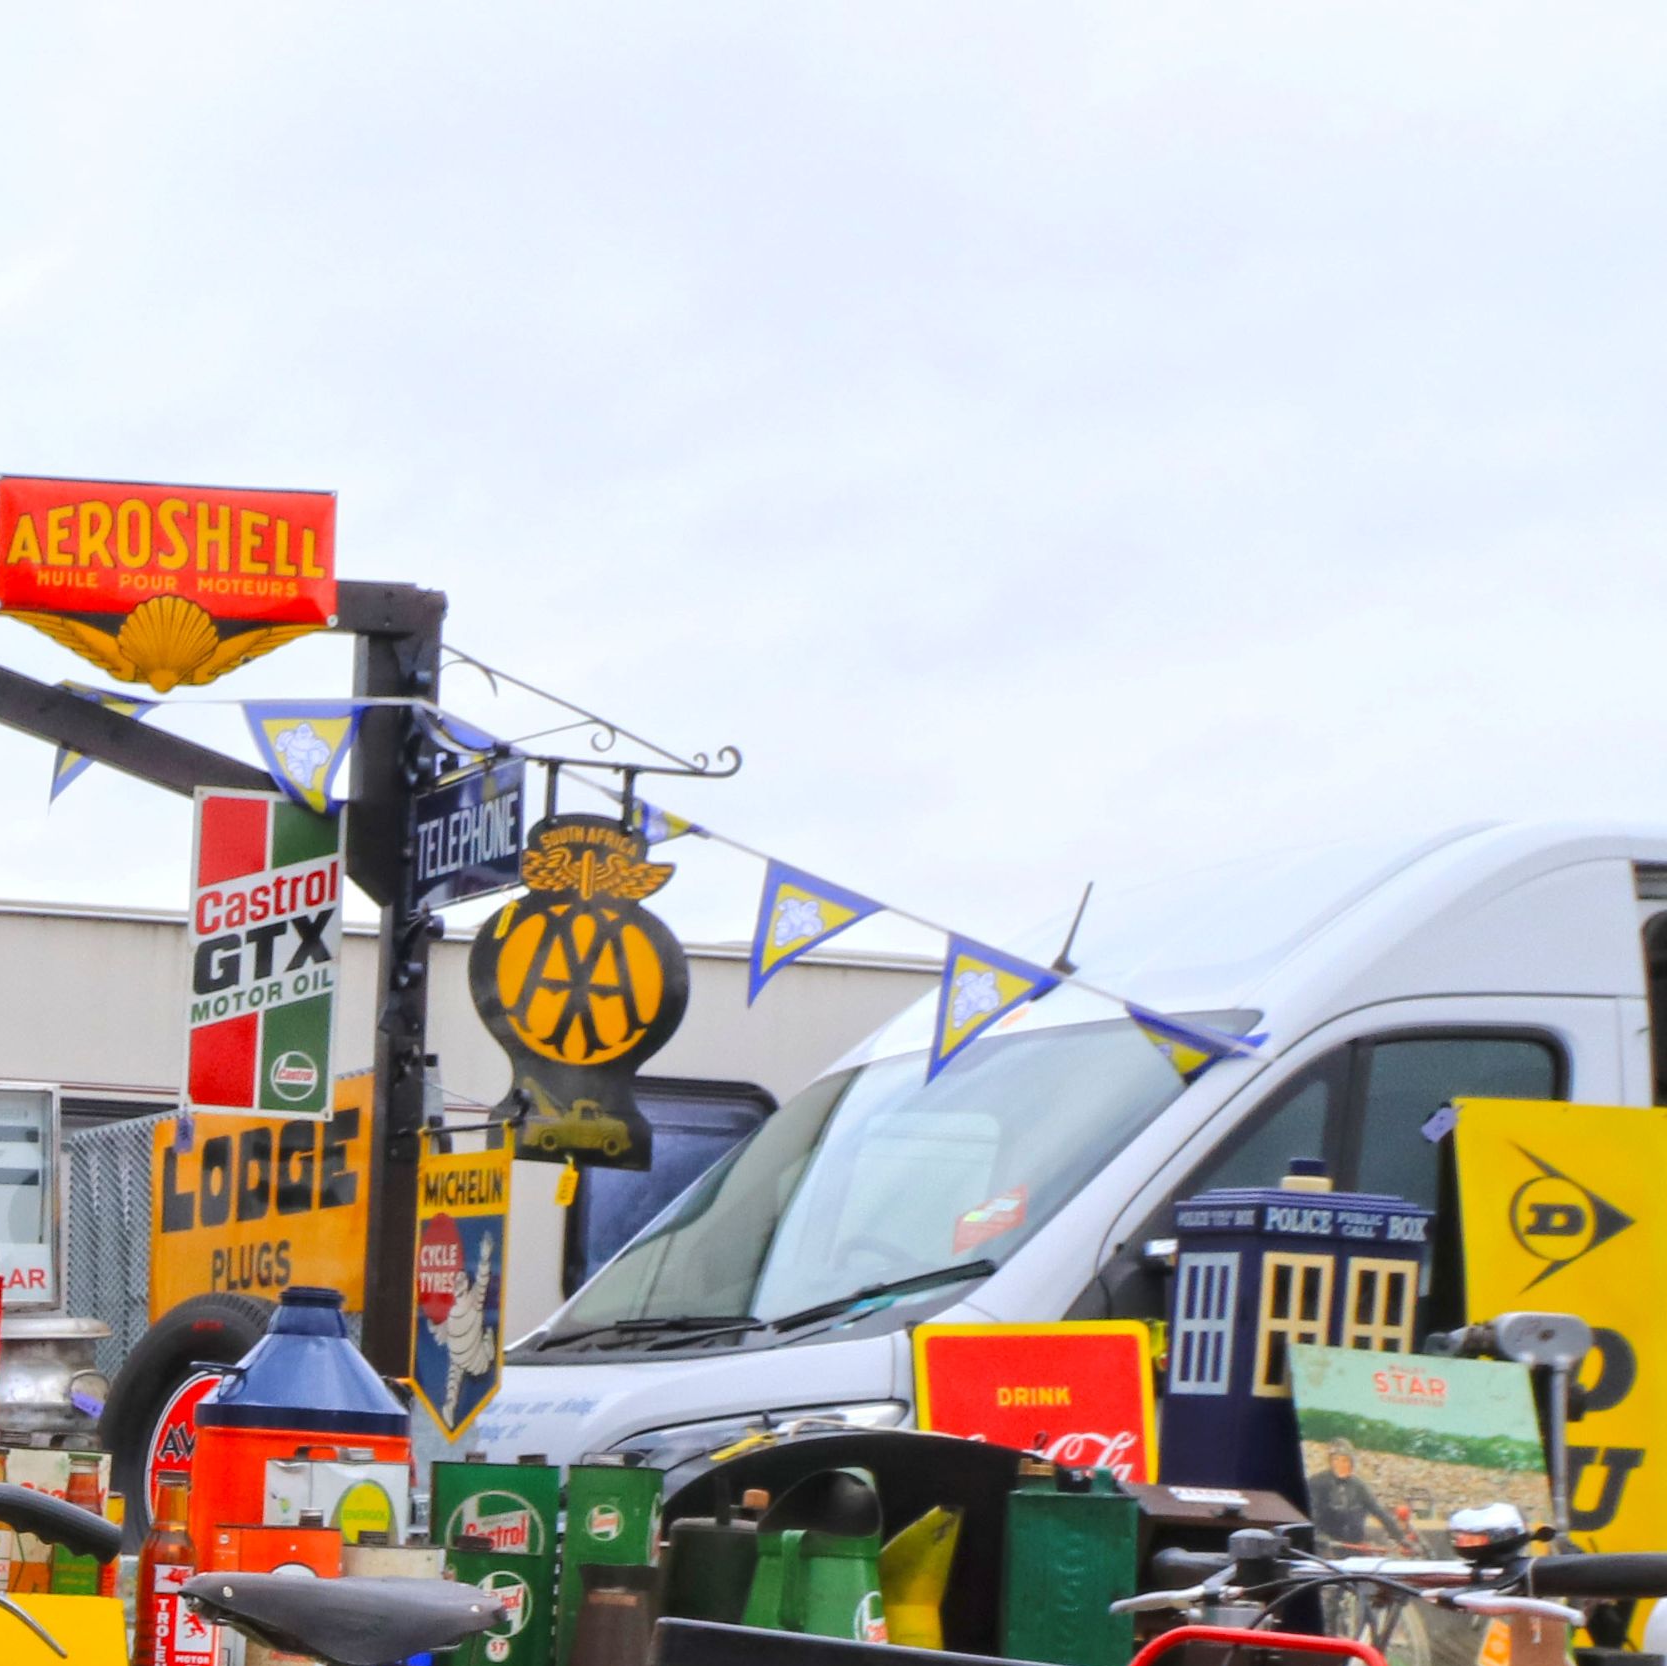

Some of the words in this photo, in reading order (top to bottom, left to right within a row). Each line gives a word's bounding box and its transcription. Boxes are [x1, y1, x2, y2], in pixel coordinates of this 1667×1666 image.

[8, 499, 325, 580] AEROSHELL
[36, 571, 98, 590] HUILE
[119, 574, 178, 593] POUR
[197, 578, 299, 599] MOTEURS
[417, 791, 518, 881] TELEPHONE
[195, 860, 338, 936] Castrol
[192, 909, 335, 995] GTX
[190, 982, 285, 1024] MOTOR
[293, 971, 335, 998] OIL
[161, 1110, 361, 1233] LODGE
[424, 1167, 503, 1206] MICHELIN
[1265, 1207, 1334, 1235] POLICE
[1336, 1211, 1384, 1225] PUBLIC
[1341, 1224, 1376, 1238] CALL
[1387, 1215, 1429, 1242] BOX
[211, 1240, 293, 1292] PLUGS
[421, 1244, 459, 1267] CYCLE
[420, 1271, 456, 1295] TYRES
[996, 1387, 1071, 1407] DRINK
[1372, 1371, 1447, 1397] STAR
[175, 1654, 210, 1665] MOTOR
